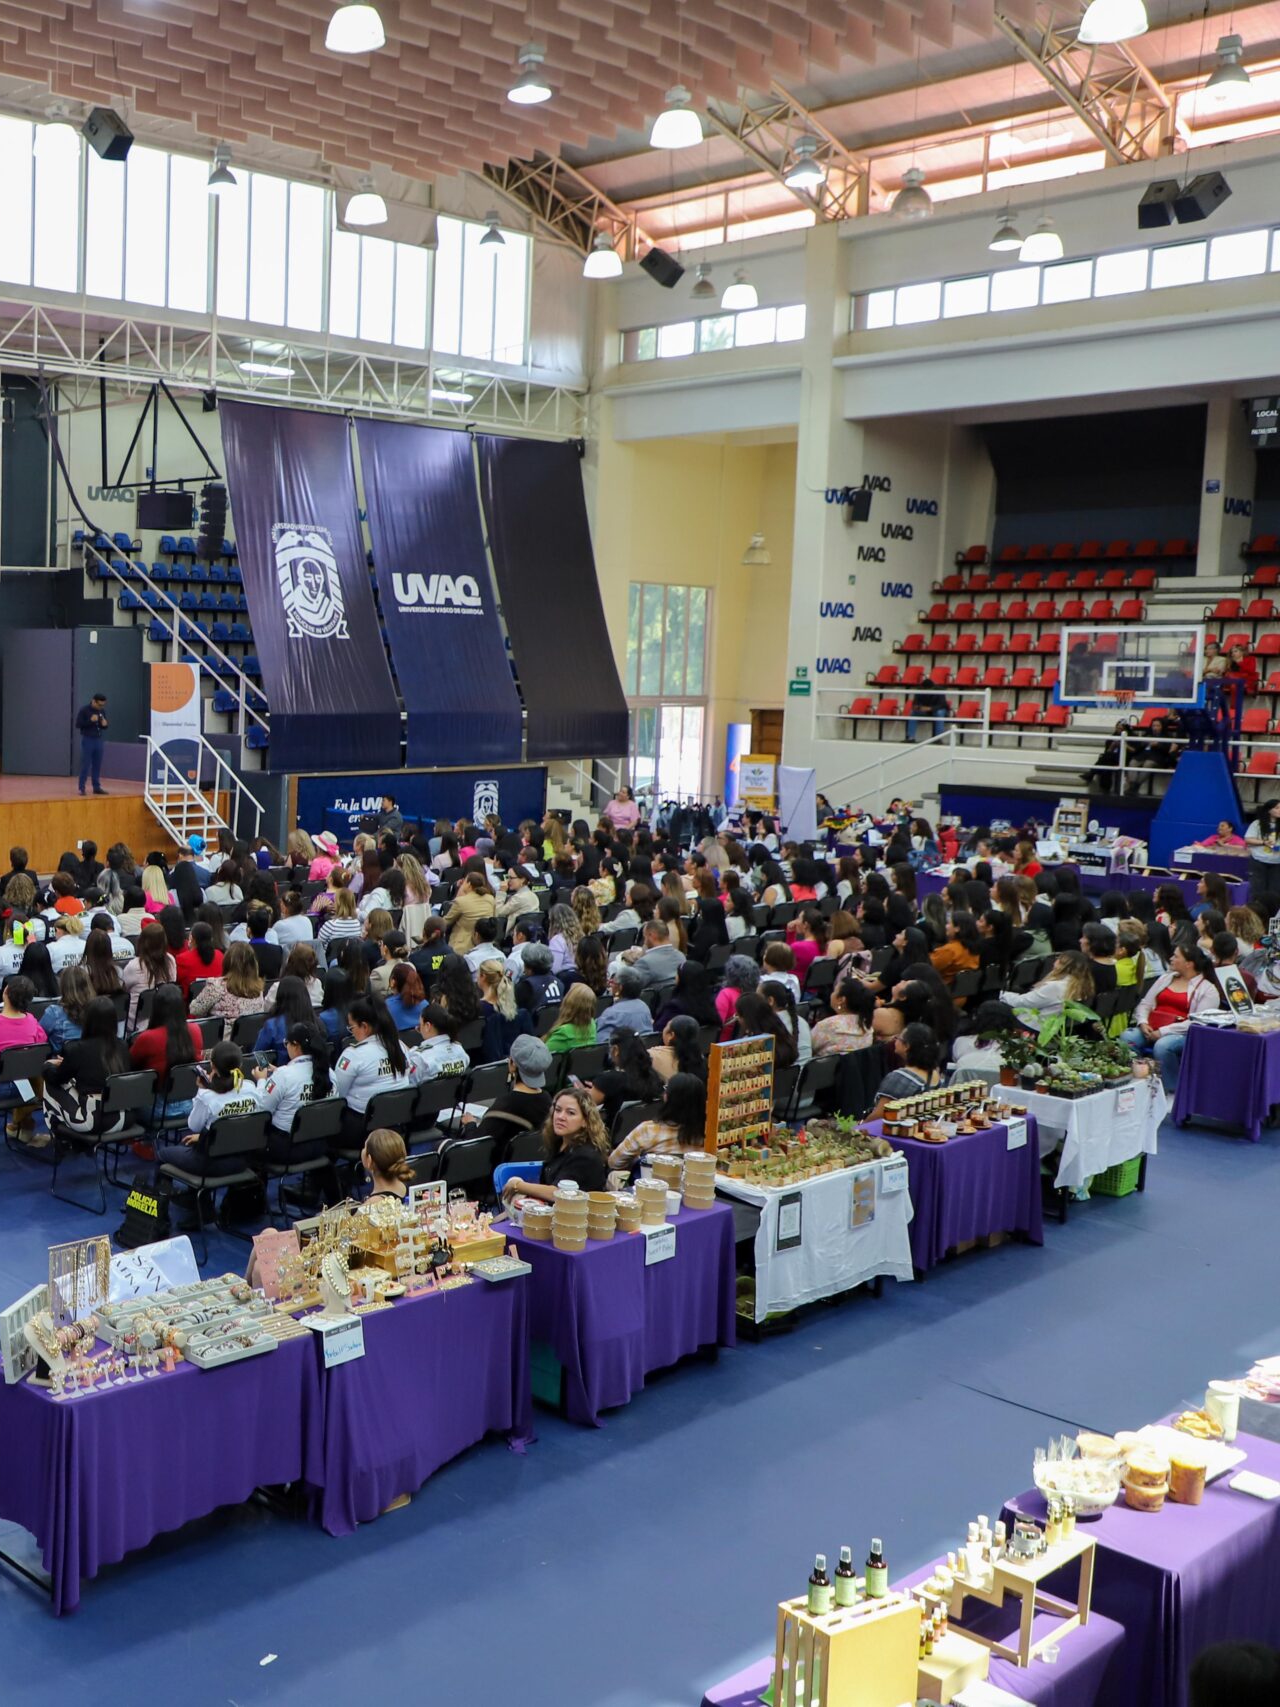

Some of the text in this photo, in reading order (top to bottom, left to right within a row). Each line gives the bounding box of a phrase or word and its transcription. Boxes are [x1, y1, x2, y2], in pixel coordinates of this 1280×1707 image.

[87, 485, 135, 503] UVAQ
[906, 497, 938, 516] UVAQ
[881, 522, 913, 541] UVAQ
[392, 573, 481, 606] UVAQ
[881, 582, 913, 598] UVAQ
[820, 602, 854, 618] UVAQ
[816, 658, 851, 674] UVAQ
[350, 797, 360, 811] la
[126, 1197, 158, 1218] MORELIA
[130, 1190, 158, 1209] POLICIA
